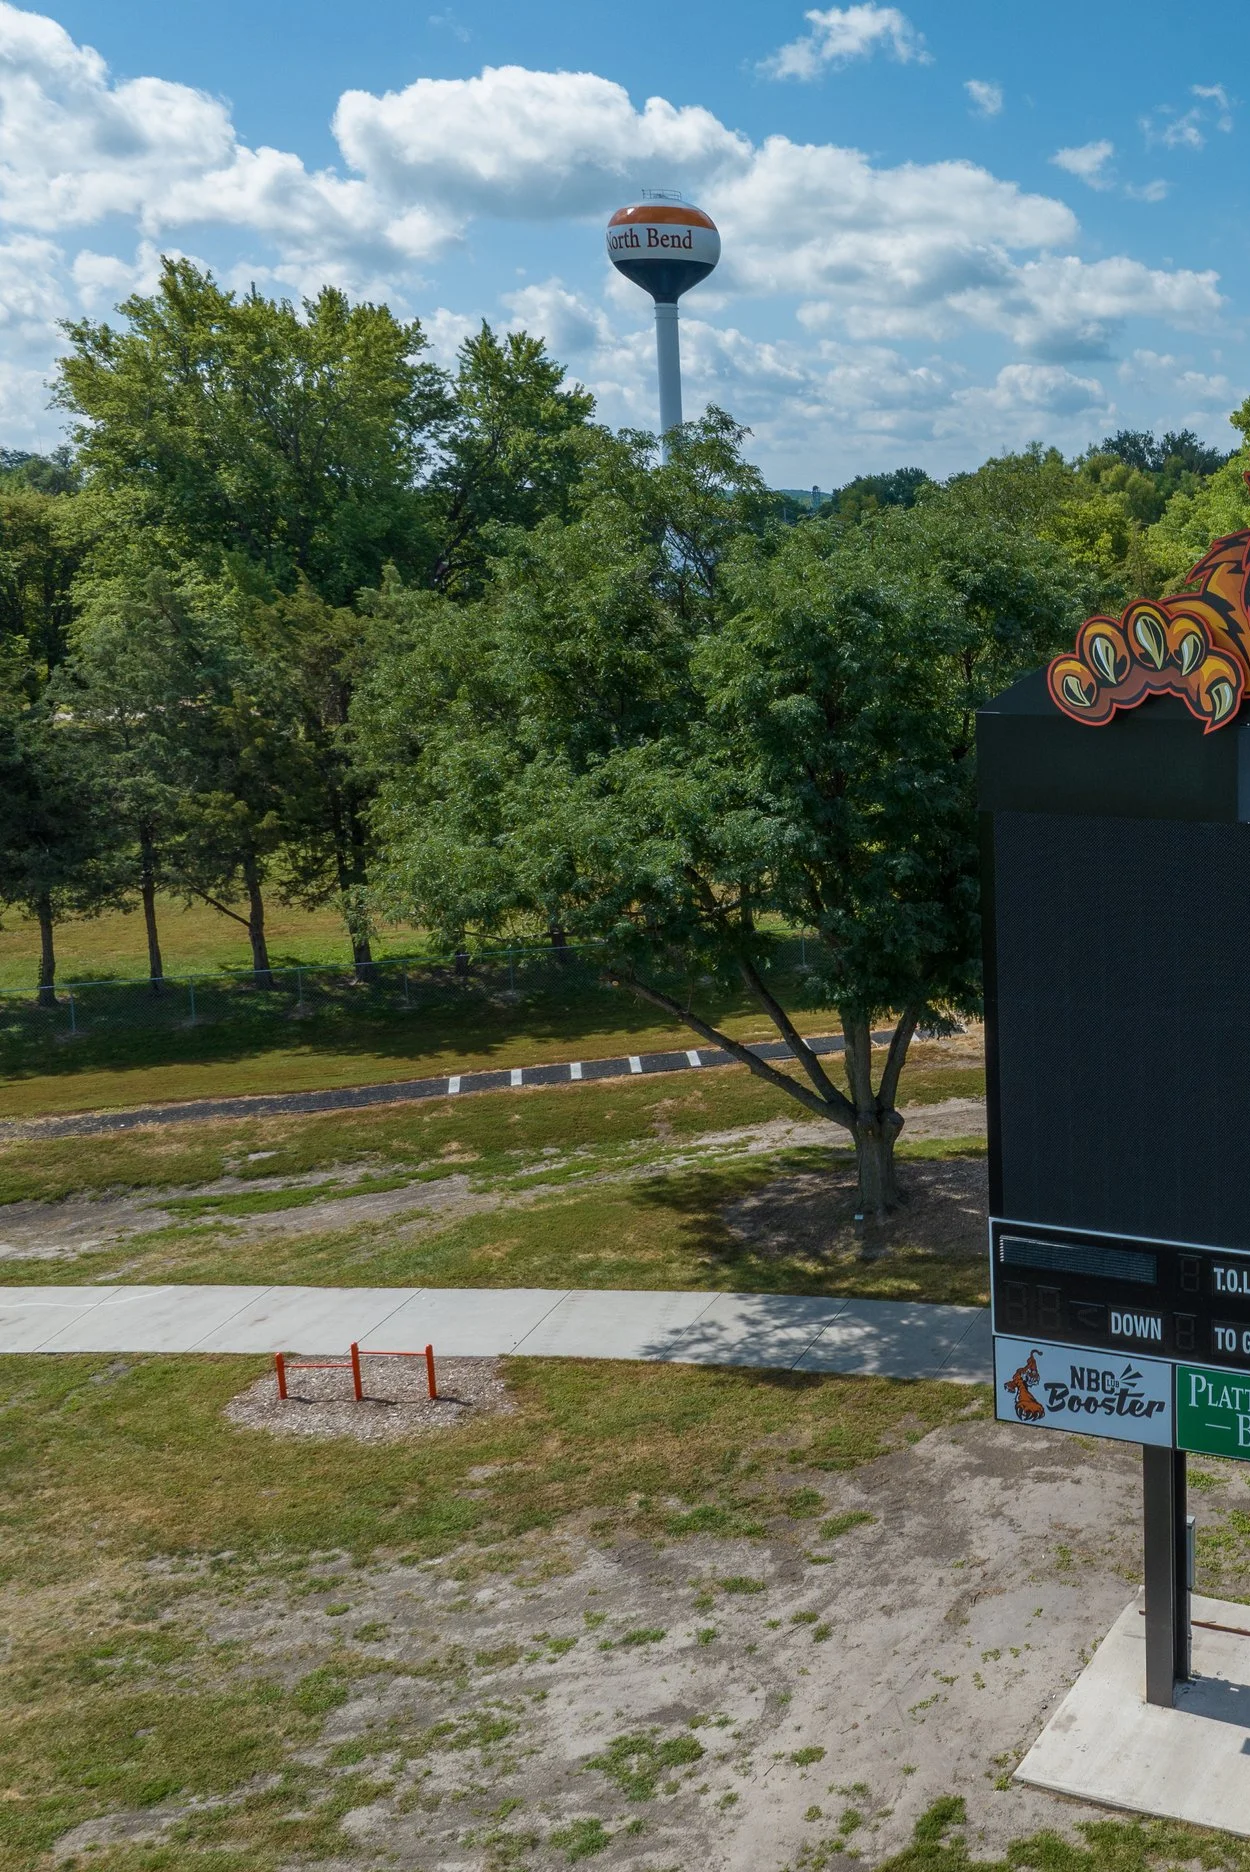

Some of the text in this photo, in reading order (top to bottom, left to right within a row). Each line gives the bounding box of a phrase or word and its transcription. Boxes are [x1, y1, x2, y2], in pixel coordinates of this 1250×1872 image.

[646, 228, 693, 249] Bend
[1111, 1311, 1162, 1341] DOWN
[1214, 1327, 1237, 1352] TO
[1044, 1382, 1165, 1419] Booster
